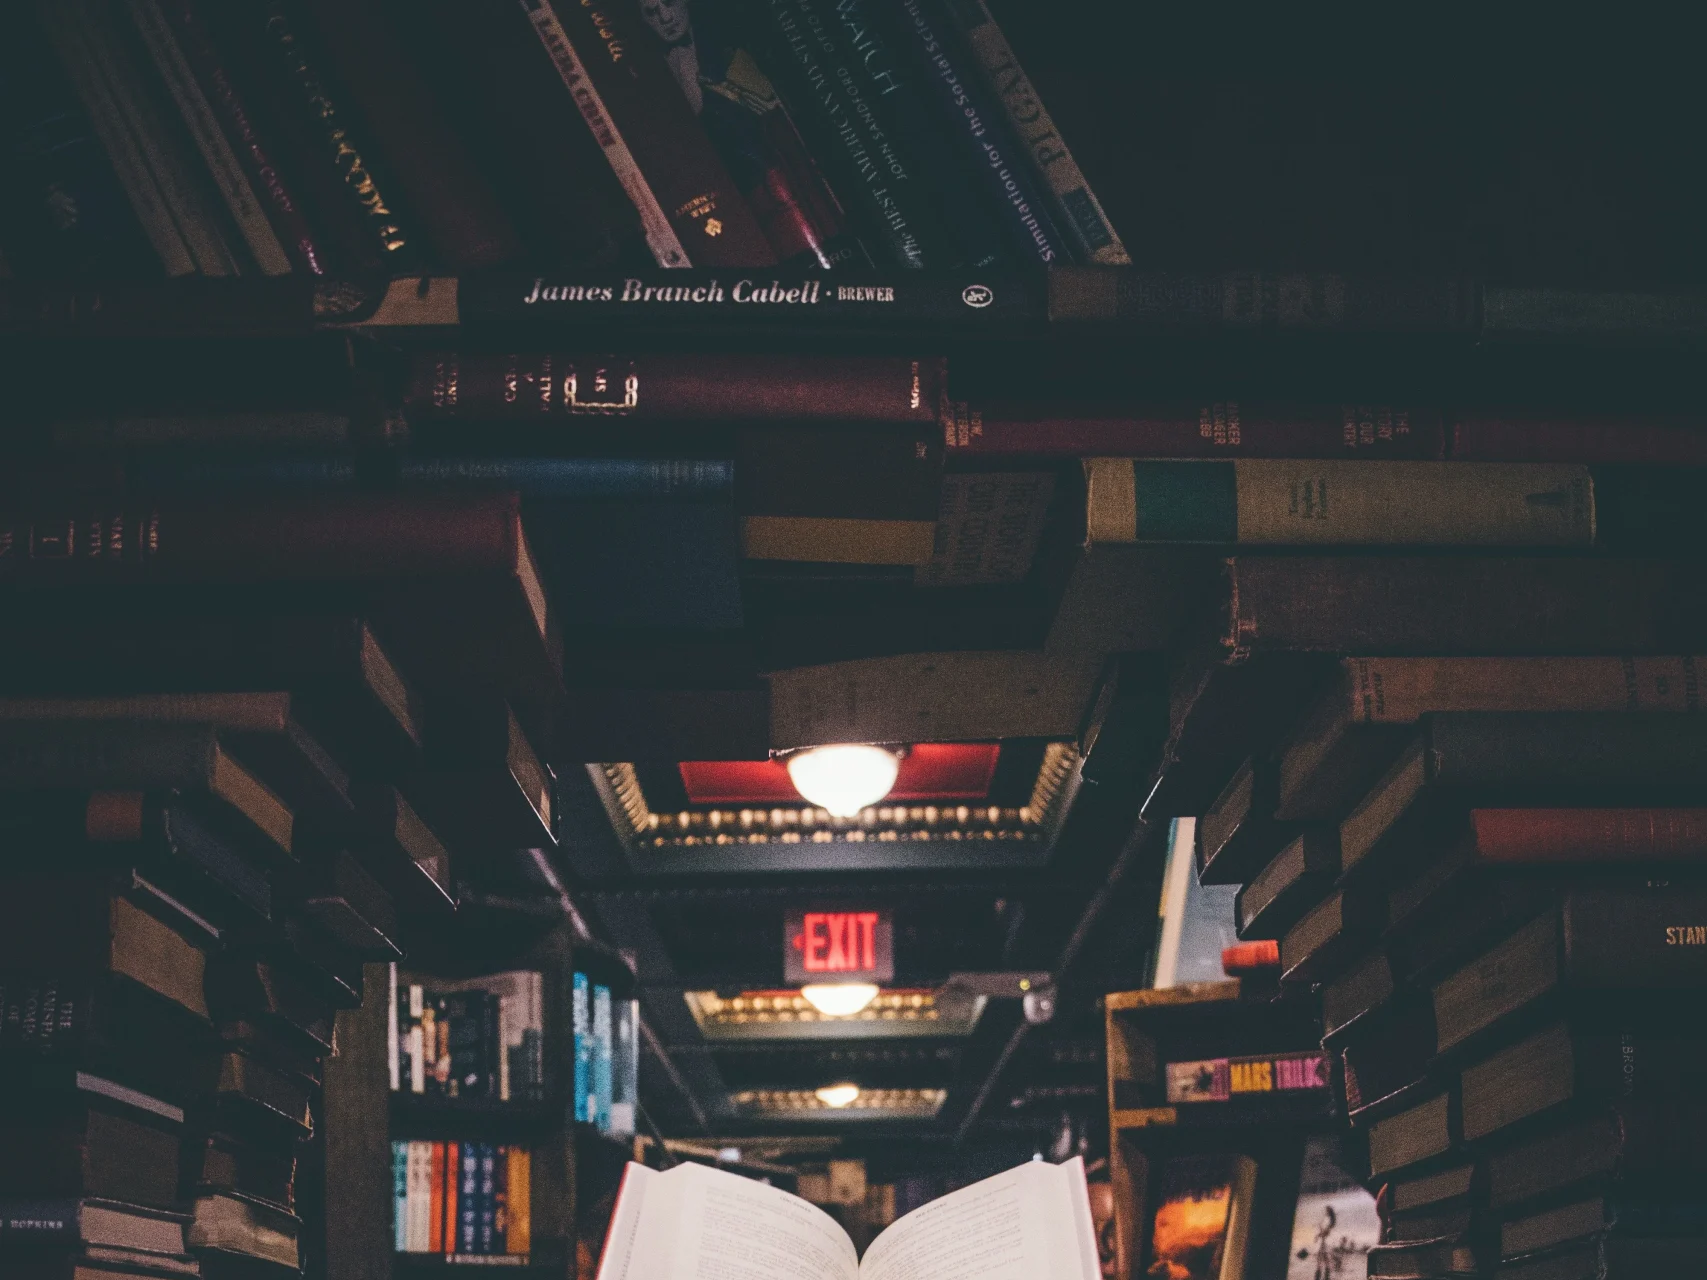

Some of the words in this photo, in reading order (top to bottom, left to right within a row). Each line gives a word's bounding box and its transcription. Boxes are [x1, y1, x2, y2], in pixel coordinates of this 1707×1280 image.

[772, 7, 830, 91] MYSTERY
[834, 65, 886, 142] SANDFORD
[930, 51, 971, 108] Social
[818, 90, 882, 184] AMERICAN
[960, 104, 988, 138] the
[878, 141, 909, 183] JOHN
[977, 138, 1005, 171] for
[871, 183, 907, 231] BEST
[993, 166, 1059, 263] Simulation
[518, 280, 613, 304] James
[620, 279, 724, 303] Branch
[732, 280, 820, 304] Cabell
[838, 286, 895, 302] BREWER
[804, 912, 878, 971] EXIT
[1230, 1062, 1272, 1093] MARS
[10, 1219, 63, 1229] HOPKINS
